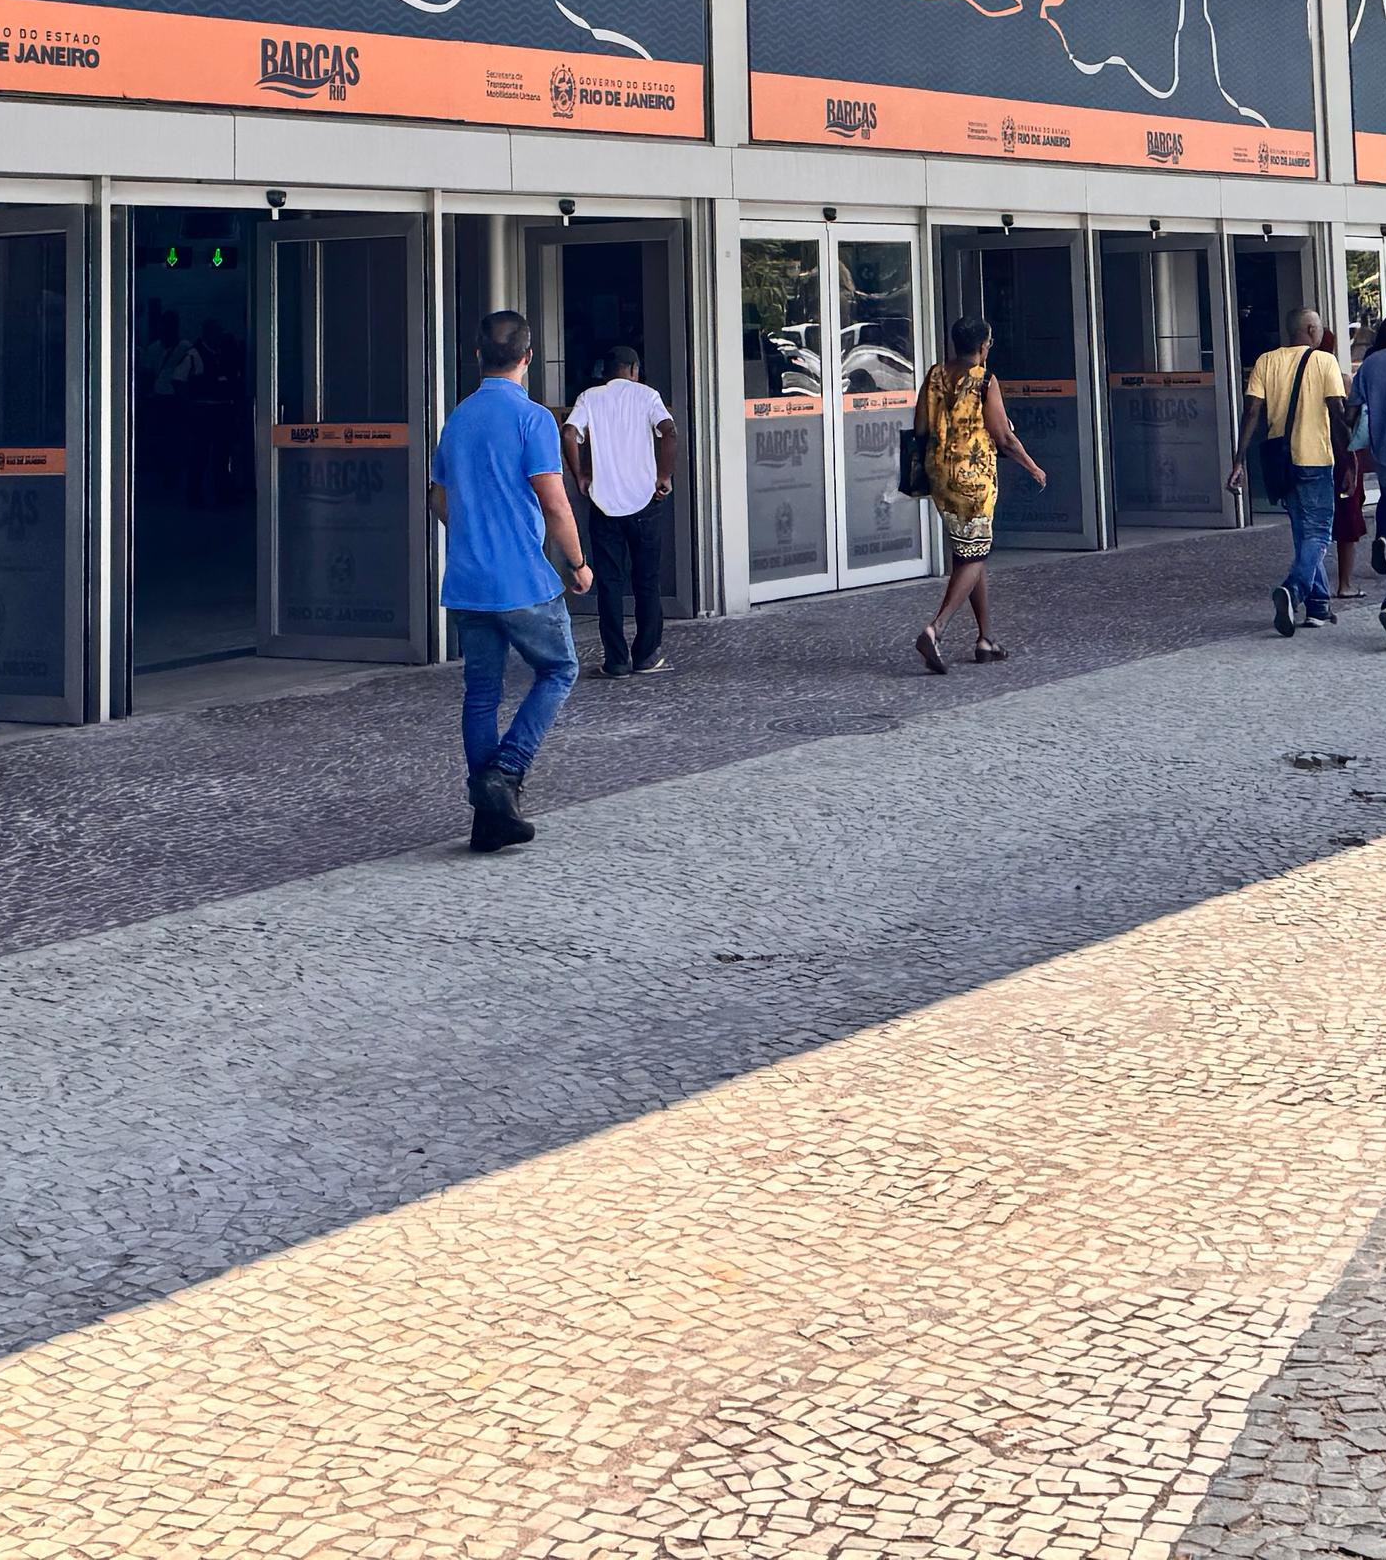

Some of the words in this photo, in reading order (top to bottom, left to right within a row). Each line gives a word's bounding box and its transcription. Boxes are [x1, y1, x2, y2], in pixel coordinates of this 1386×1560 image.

[19, 28, 38, 40] DO
[46, 31, 101, 46] ESTADO
[14, 43, 100, 69] JANEIRO
[261, 38, 360, 86] BARCAS
[329, 85, 347, 101] RIO
[579, 77, 623, 88] GOVERNO
[626, 81, 638, 89] DO
[642, 82, 676, 93] ESTADO
[579, 88, 603, 105] RIO
[605, 90, 621, 107] DE
[624, 92, 675, 111] JANEIRO
[826, 98, 877, 130] BARCAS
[1146, 131, 1183, 156] BARCAS
[755, 428, 809, 457] BARCAS
